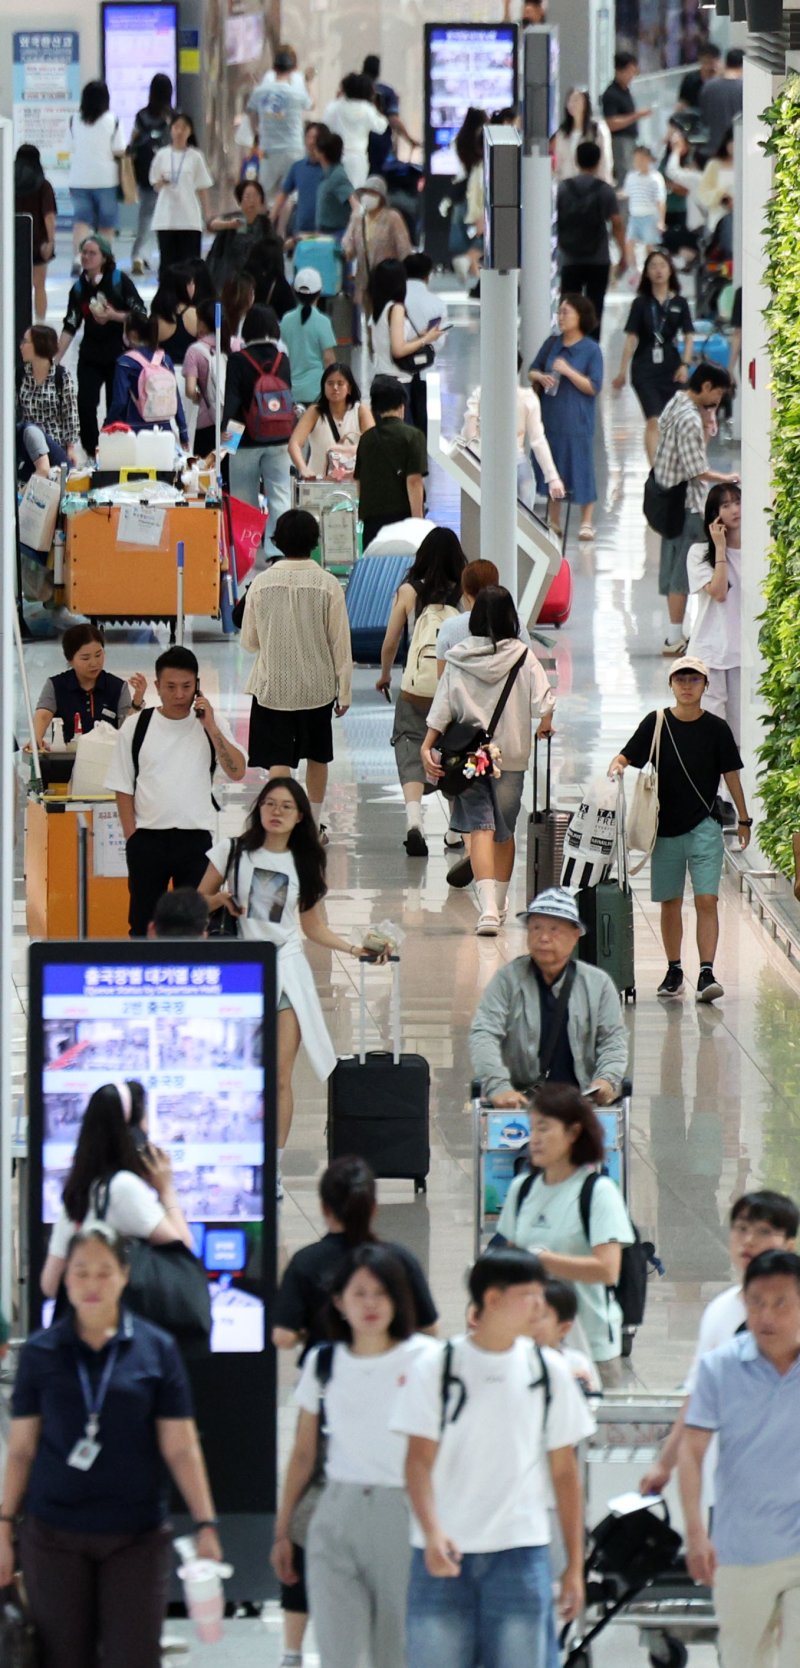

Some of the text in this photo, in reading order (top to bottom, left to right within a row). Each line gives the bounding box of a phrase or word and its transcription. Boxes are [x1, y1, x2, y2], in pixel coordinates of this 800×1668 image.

[85, 967, 221, 985] 출국장별 대기열 상황
[147, 1001, 185, 1015] 출국장
